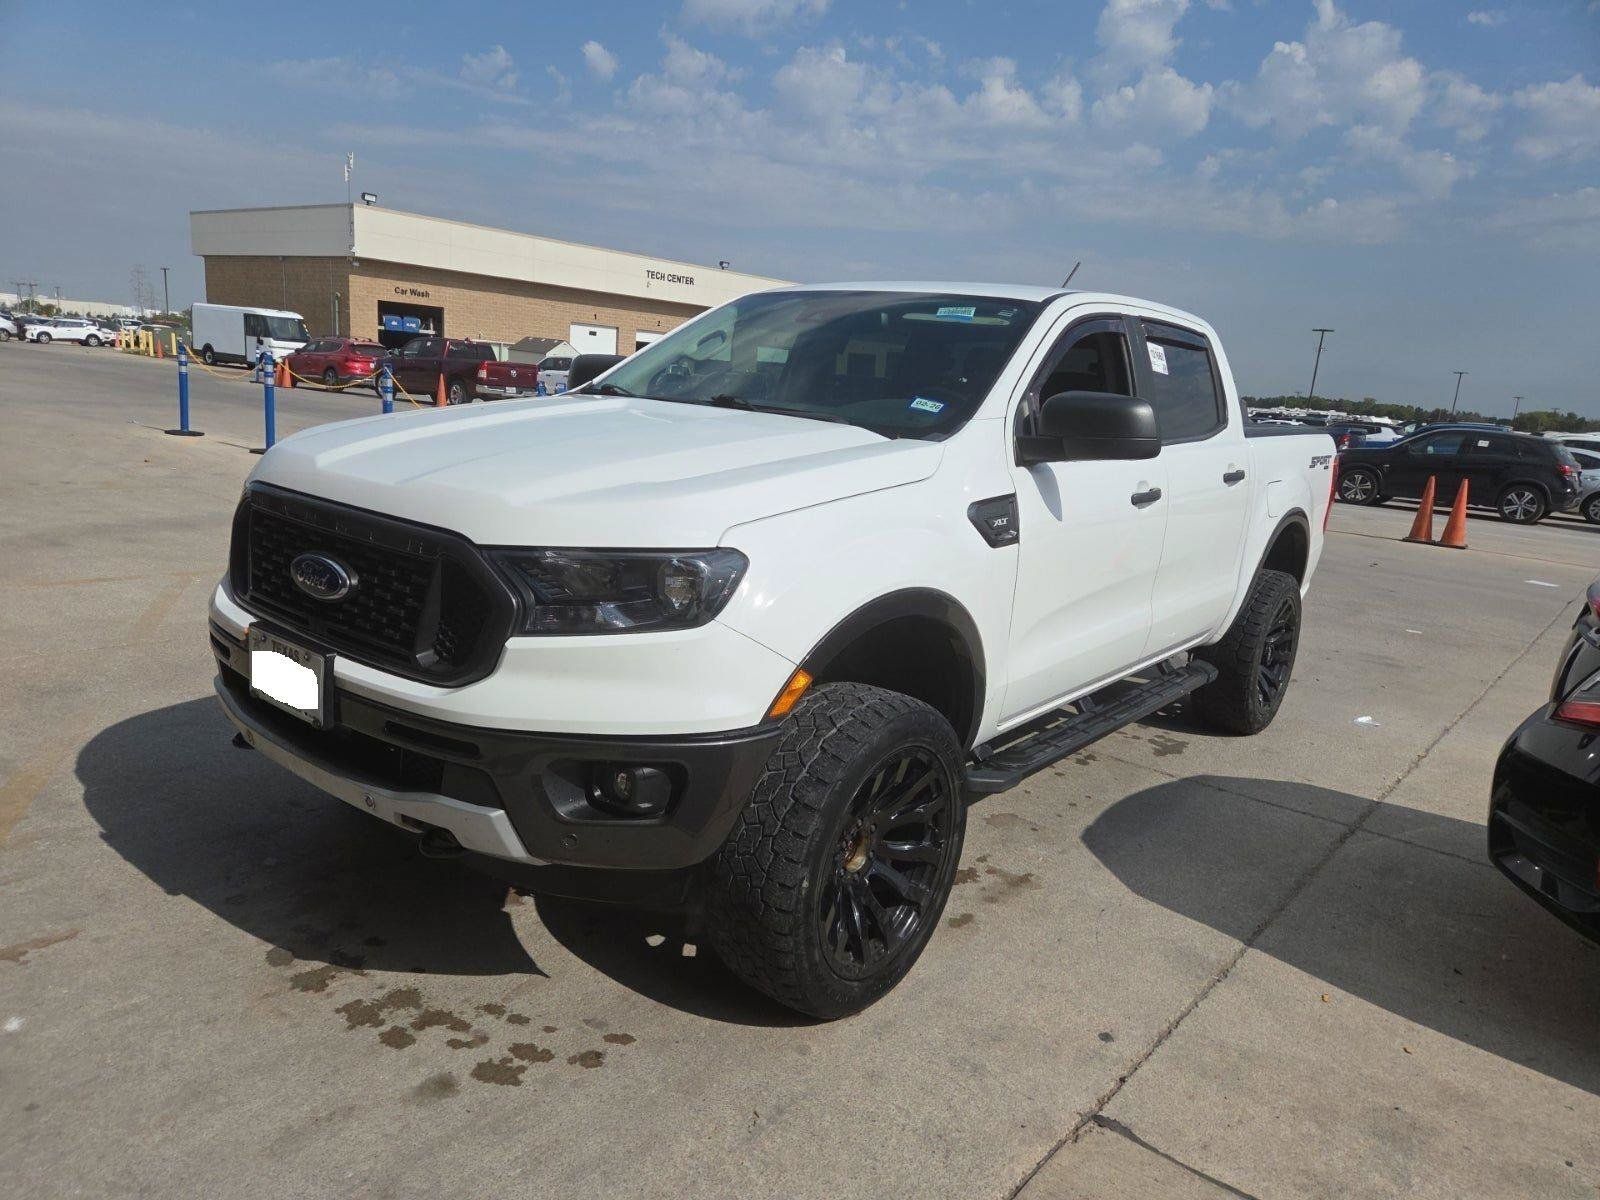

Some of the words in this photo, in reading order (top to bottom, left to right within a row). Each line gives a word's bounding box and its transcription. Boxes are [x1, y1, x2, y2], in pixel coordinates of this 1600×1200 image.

[646, 270, 665, 281] TECH
[667, 273, 695, 285] CENTER
[394, 286, 407, 296] Car
[409, 288, 430, 298] Wash
[993, 517, 1008, 527] XLT
